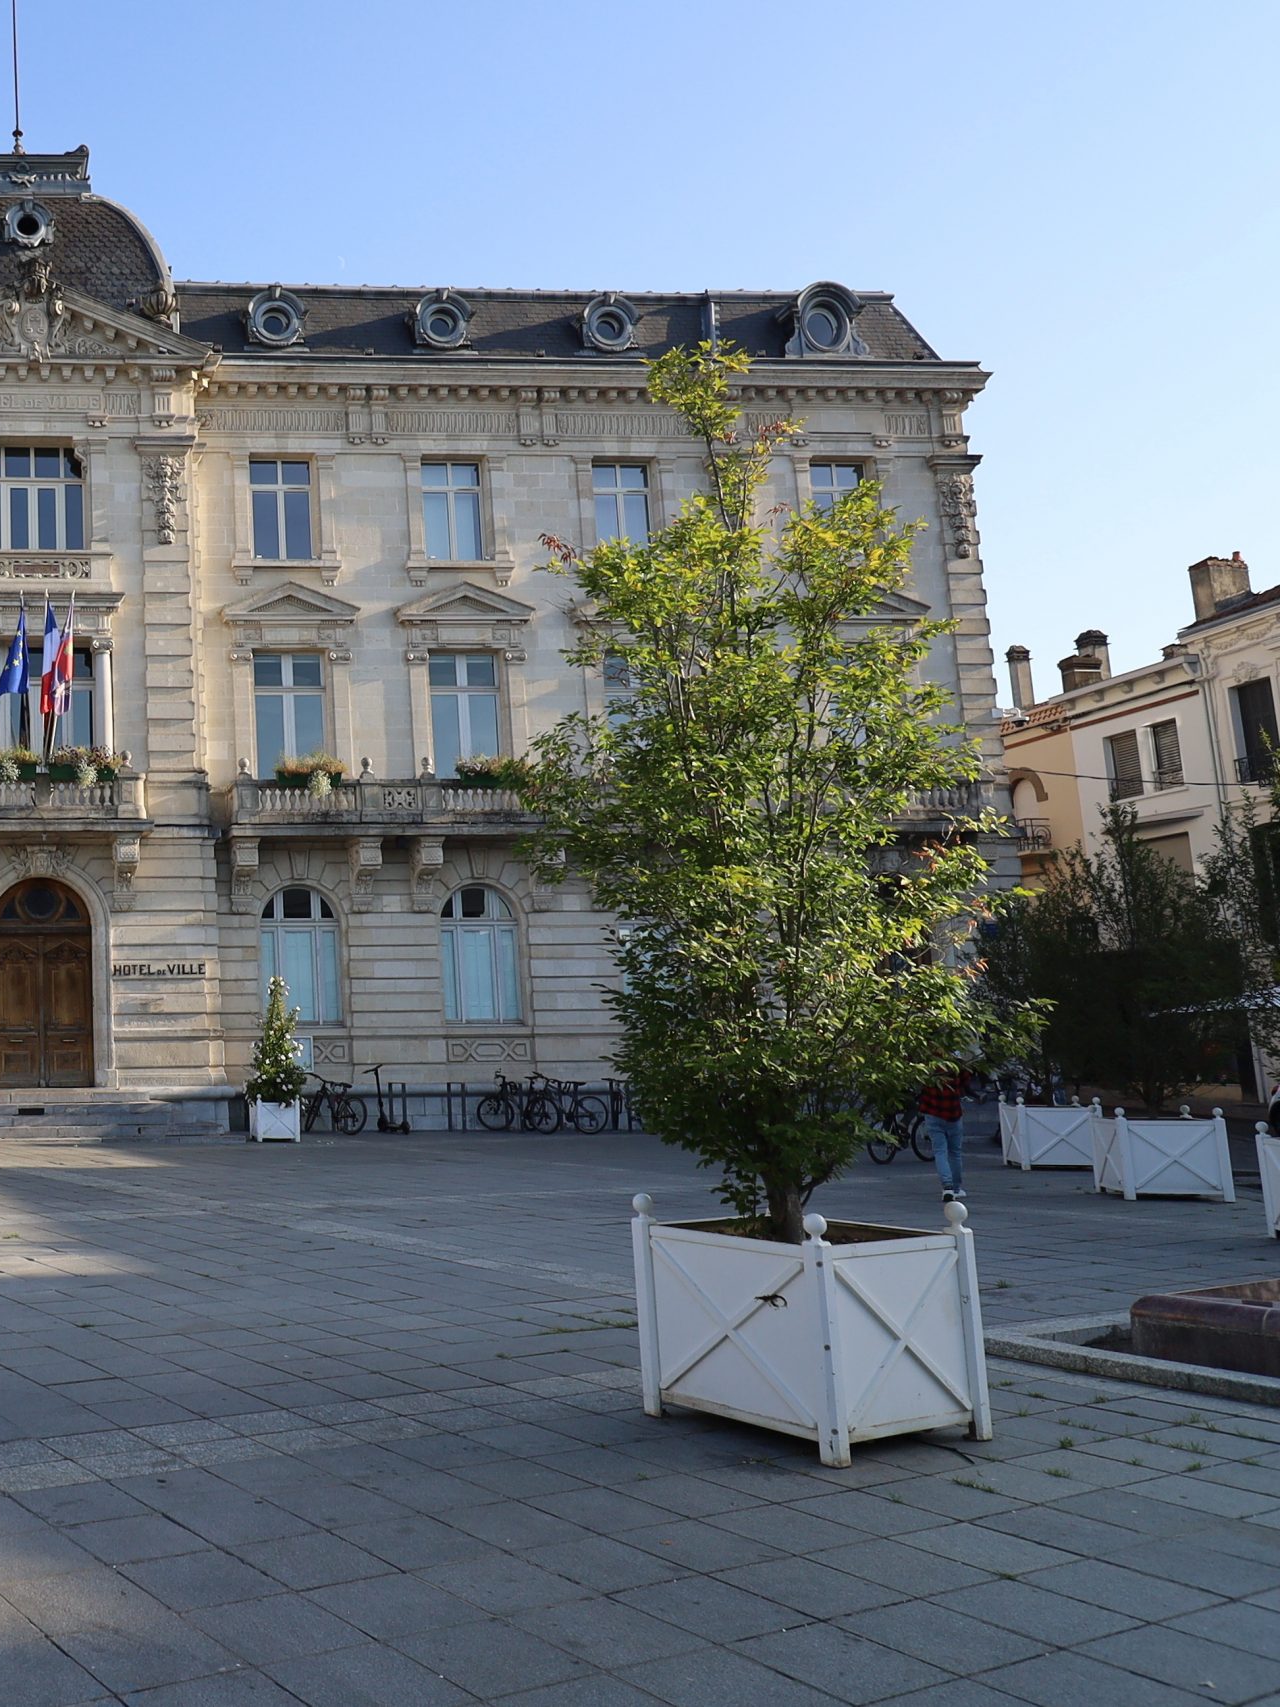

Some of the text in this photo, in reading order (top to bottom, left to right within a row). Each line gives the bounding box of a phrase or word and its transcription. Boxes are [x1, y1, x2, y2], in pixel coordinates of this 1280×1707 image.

[24, 399, 43, 409] DE
[46, 395, 100, 409] VILLE
[113, 964, 155, 976] HOTEL
[167, 964, 205, 975] VILLE
